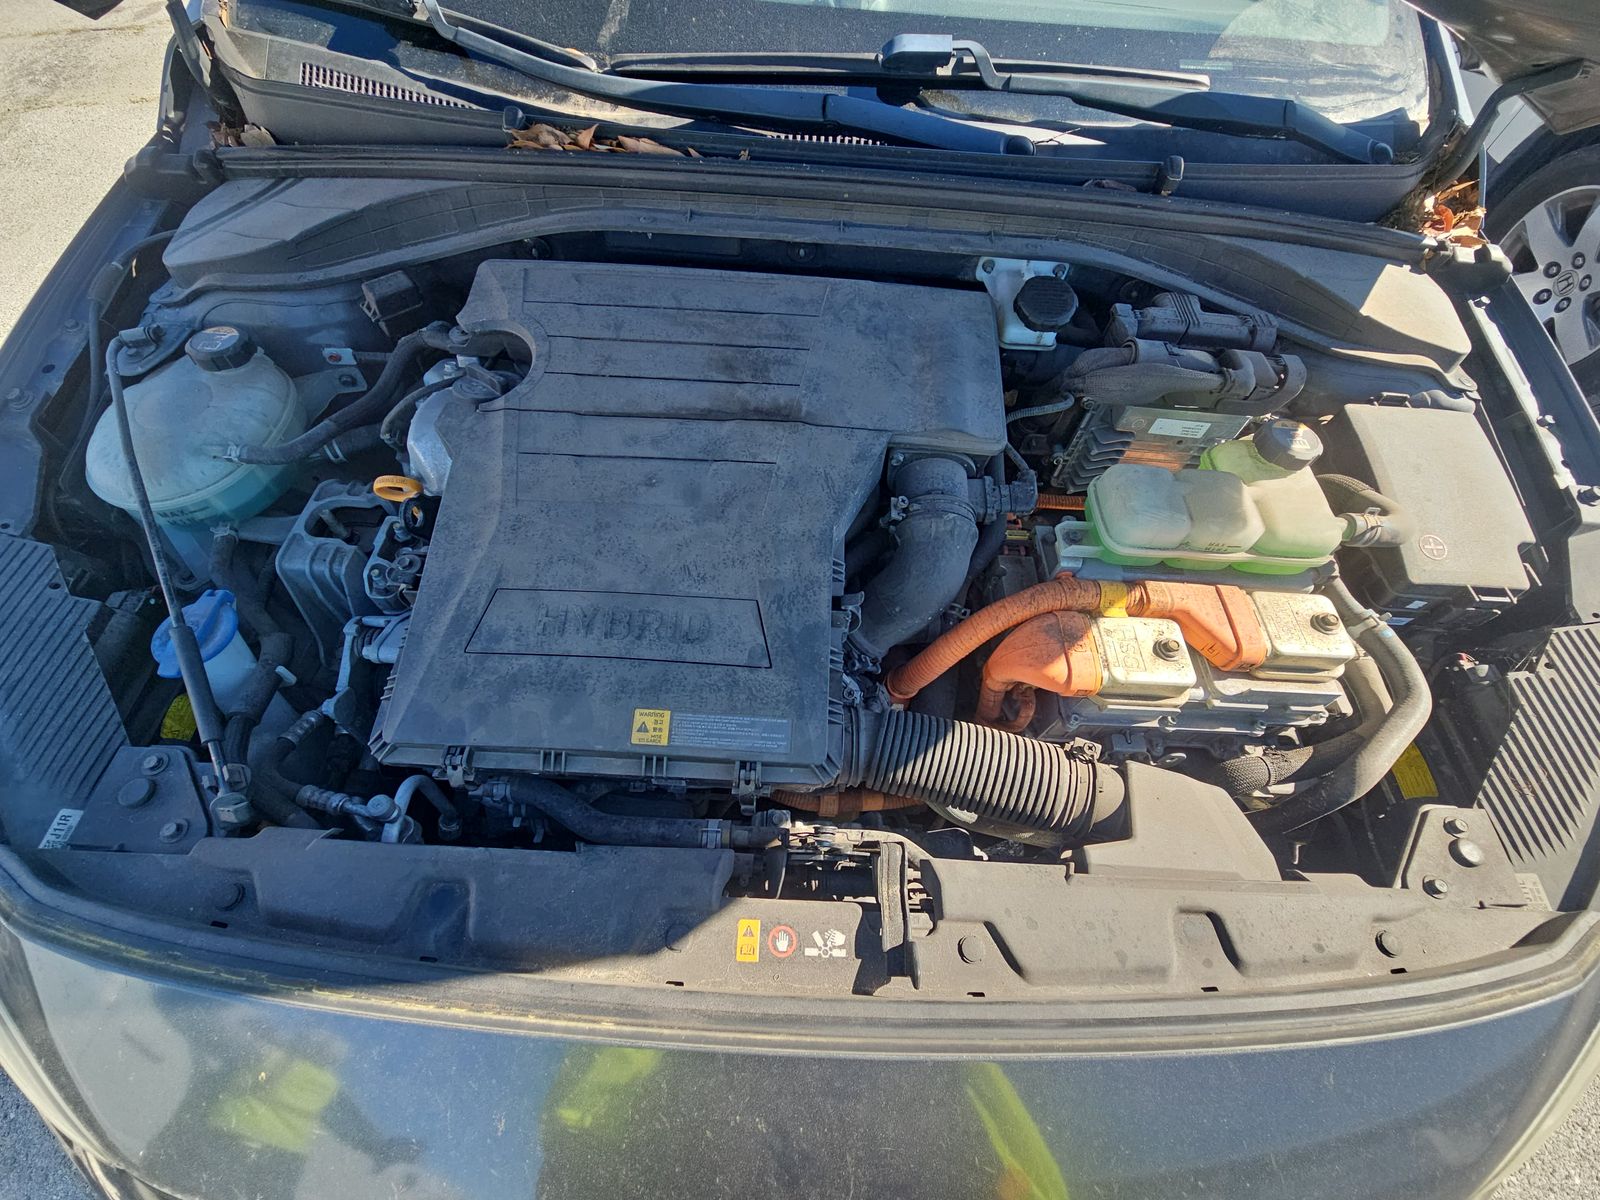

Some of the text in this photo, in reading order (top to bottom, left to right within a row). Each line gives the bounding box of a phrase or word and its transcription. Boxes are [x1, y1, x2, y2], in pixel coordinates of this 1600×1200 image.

[157, 509, 185, 518] MAX
[536, 603, 713, 643] HYBRID
[50, 814, 73, 839] J11R
